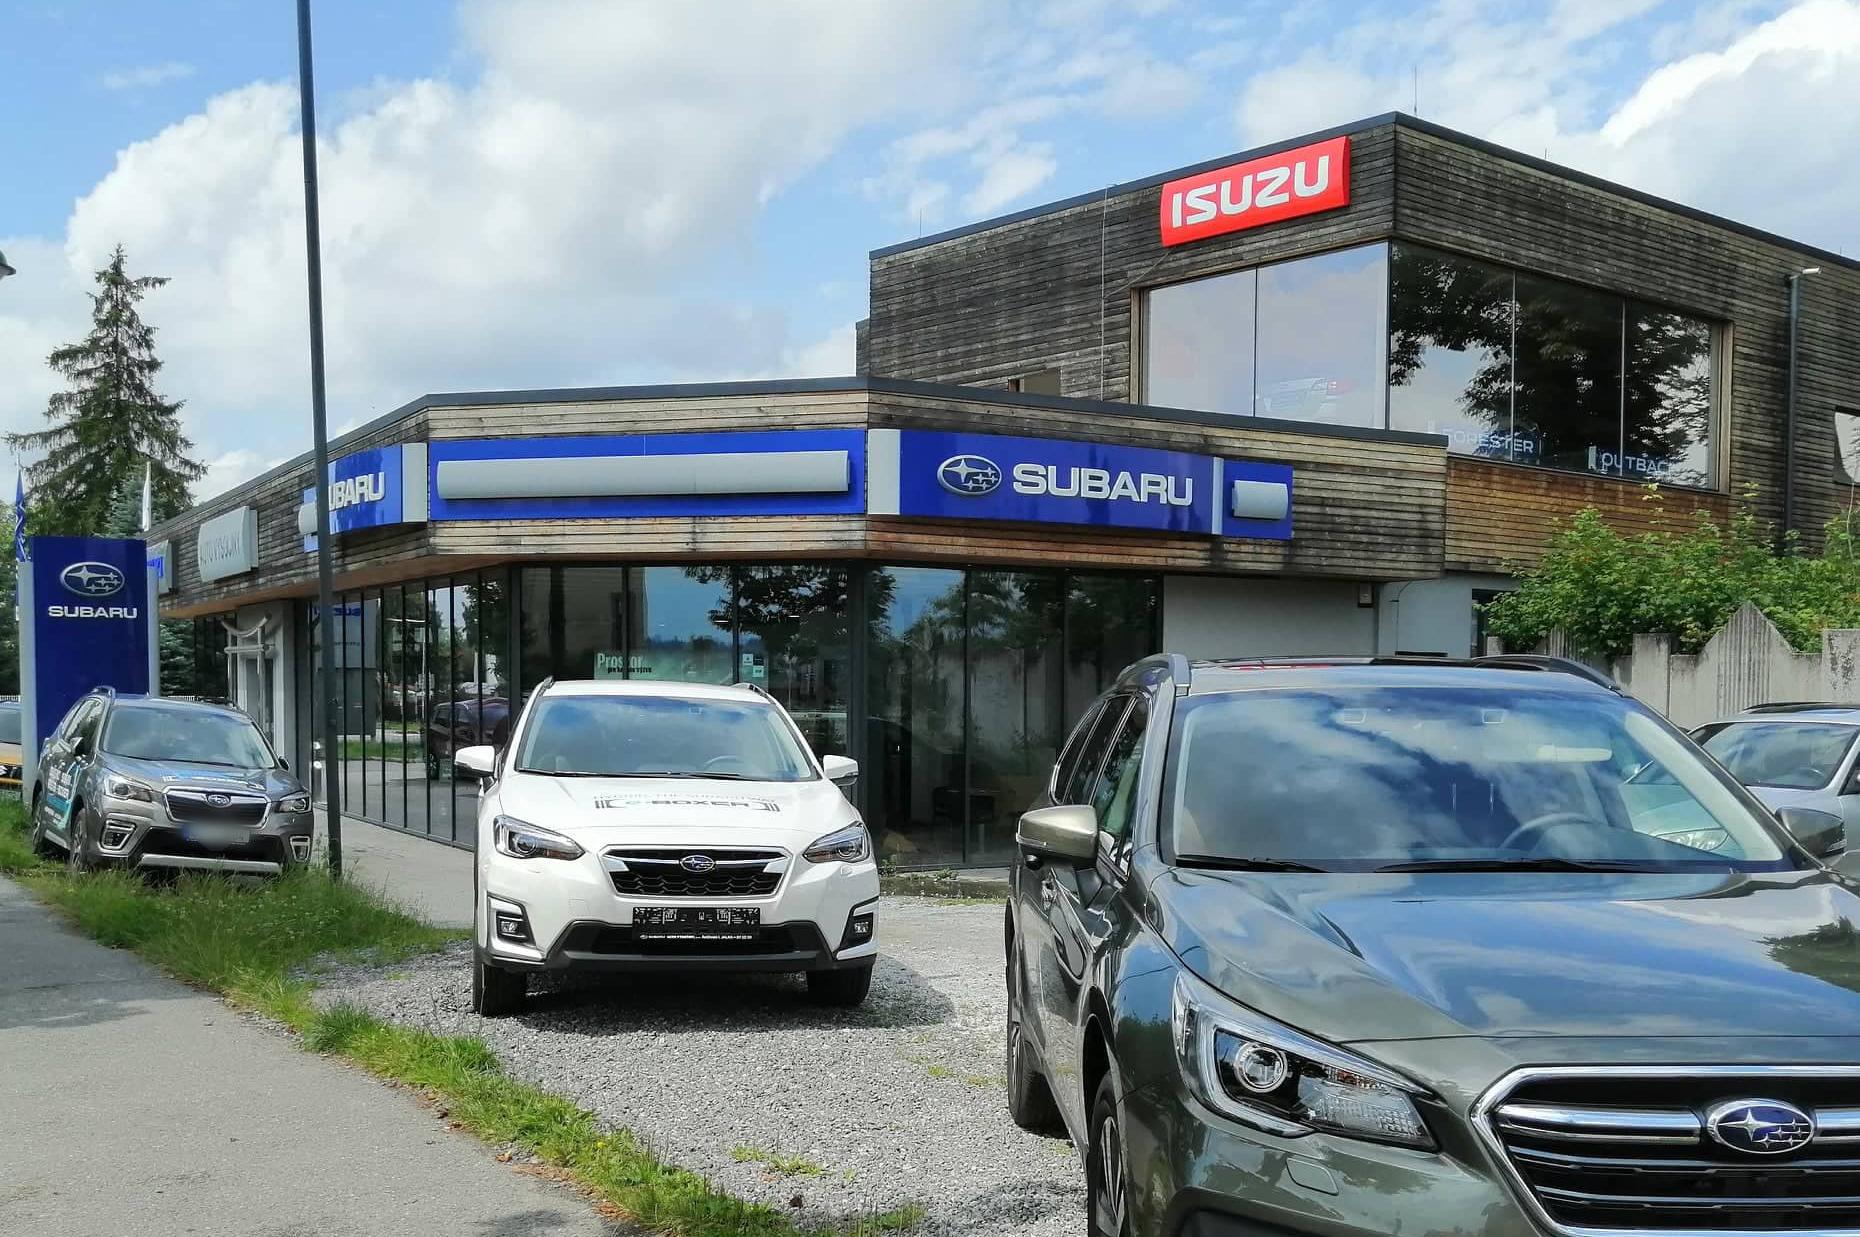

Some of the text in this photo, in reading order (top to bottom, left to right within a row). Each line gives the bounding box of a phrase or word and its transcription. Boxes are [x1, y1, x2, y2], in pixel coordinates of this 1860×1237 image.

[1172, 154, 1330, 229] ISUZU
[327, 471, 385, 512] UBARU
[1012, 463, 1194, 506] SUBARU
[47, 605, 139, 619] SUBARU
[597, 652, 643, 669] Prosor
